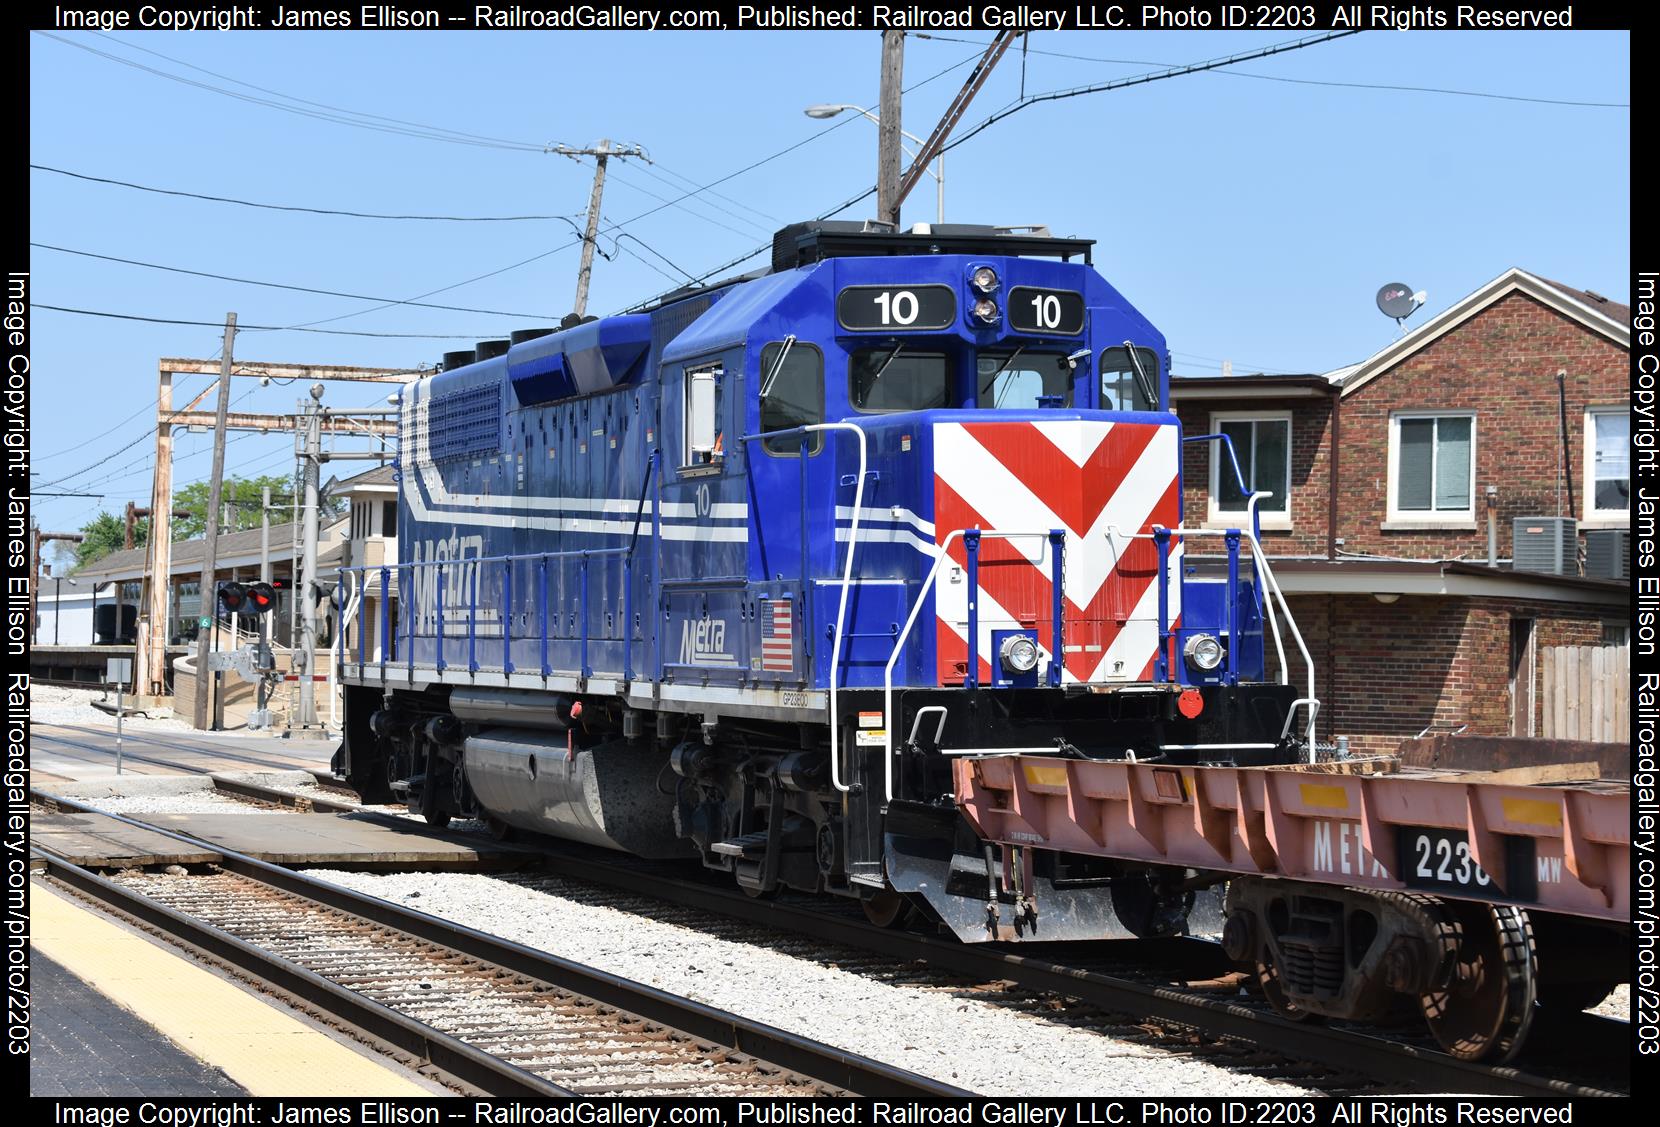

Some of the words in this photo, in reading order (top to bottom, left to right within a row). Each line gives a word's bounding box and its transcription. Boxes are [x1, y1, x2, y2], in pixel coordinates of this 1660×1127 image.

[874, 290, 919, 325] 10
[1031, 295, 1061, 329] 10
[695, 483, 710, 516] 10
[408, 527, 483, 635] Metra
[680, 614, 726, 665] Metra
[1537, 856, 1562, 883] MW
